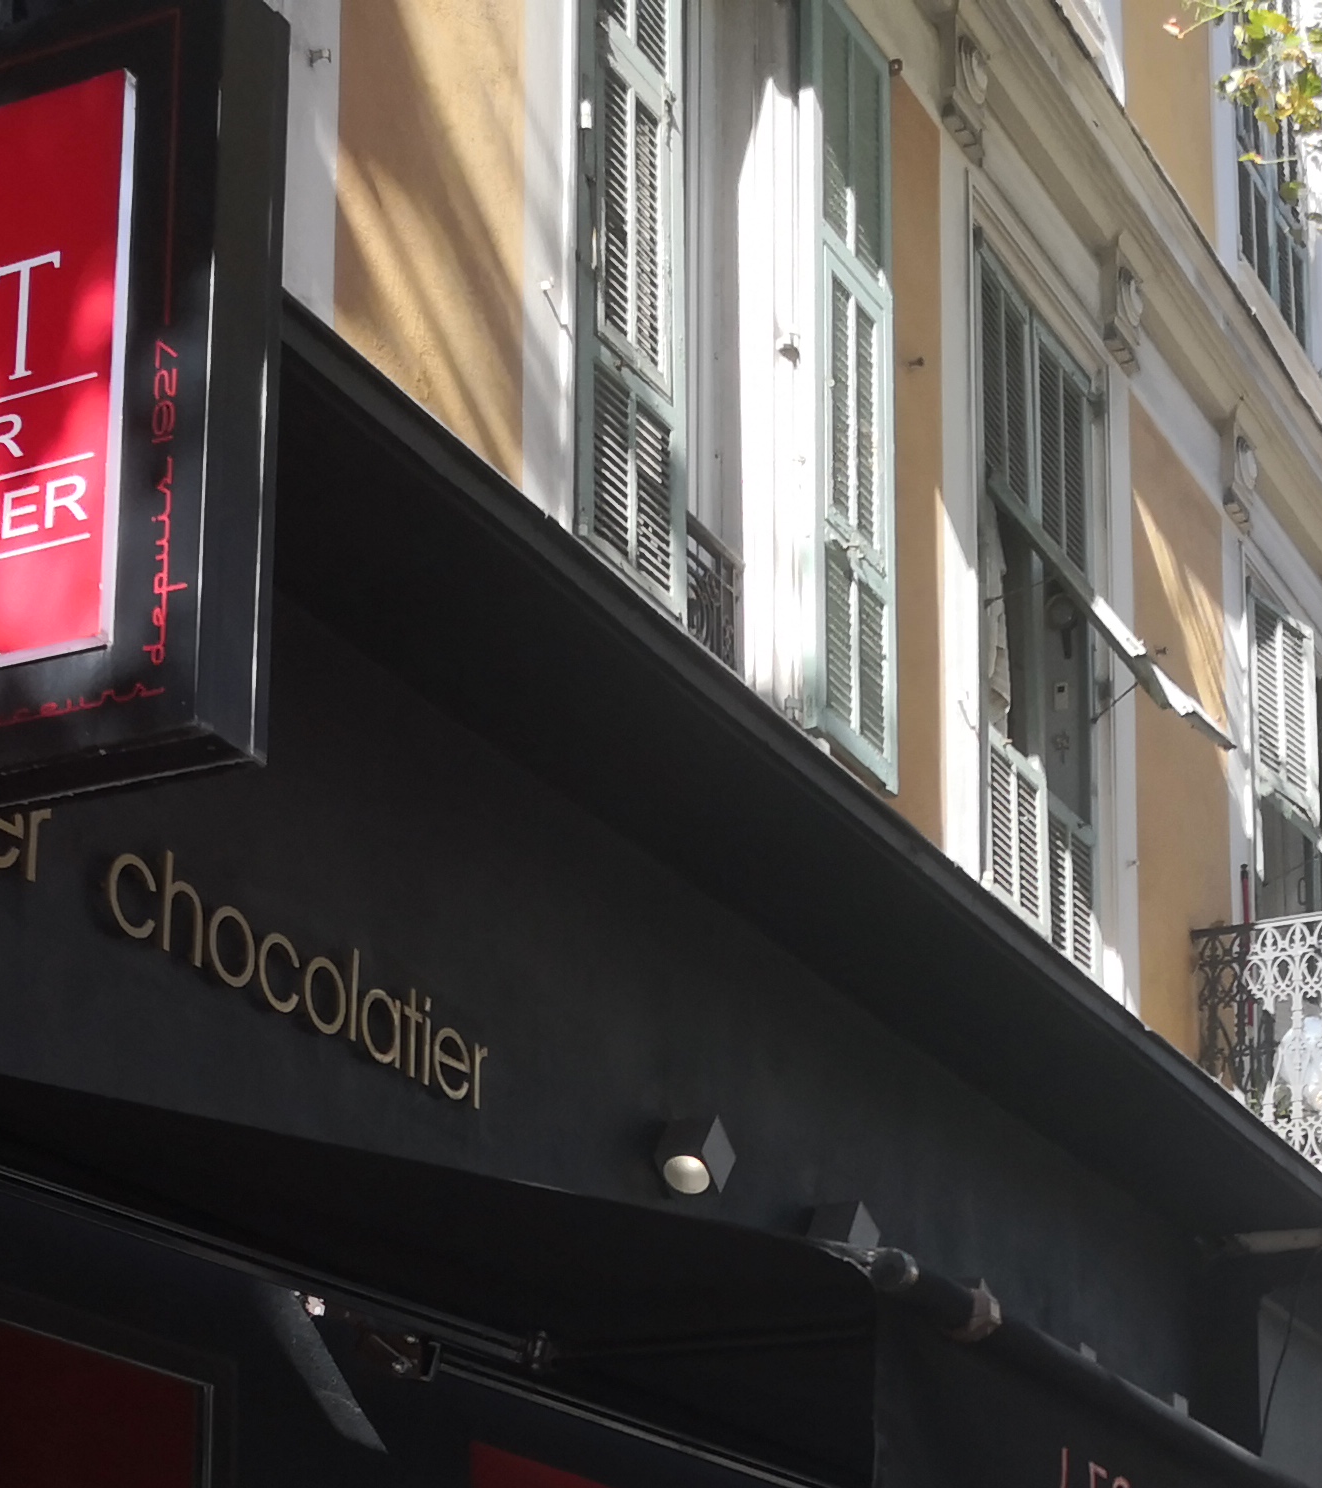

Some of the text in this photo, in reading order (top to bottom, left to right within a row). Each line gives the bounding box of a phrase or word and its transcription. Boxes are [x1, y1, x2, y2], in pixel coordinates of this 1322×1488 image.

[149, 341, 188, 665] depuis 1927
[109, 850, 488, 1109] chocolatier
